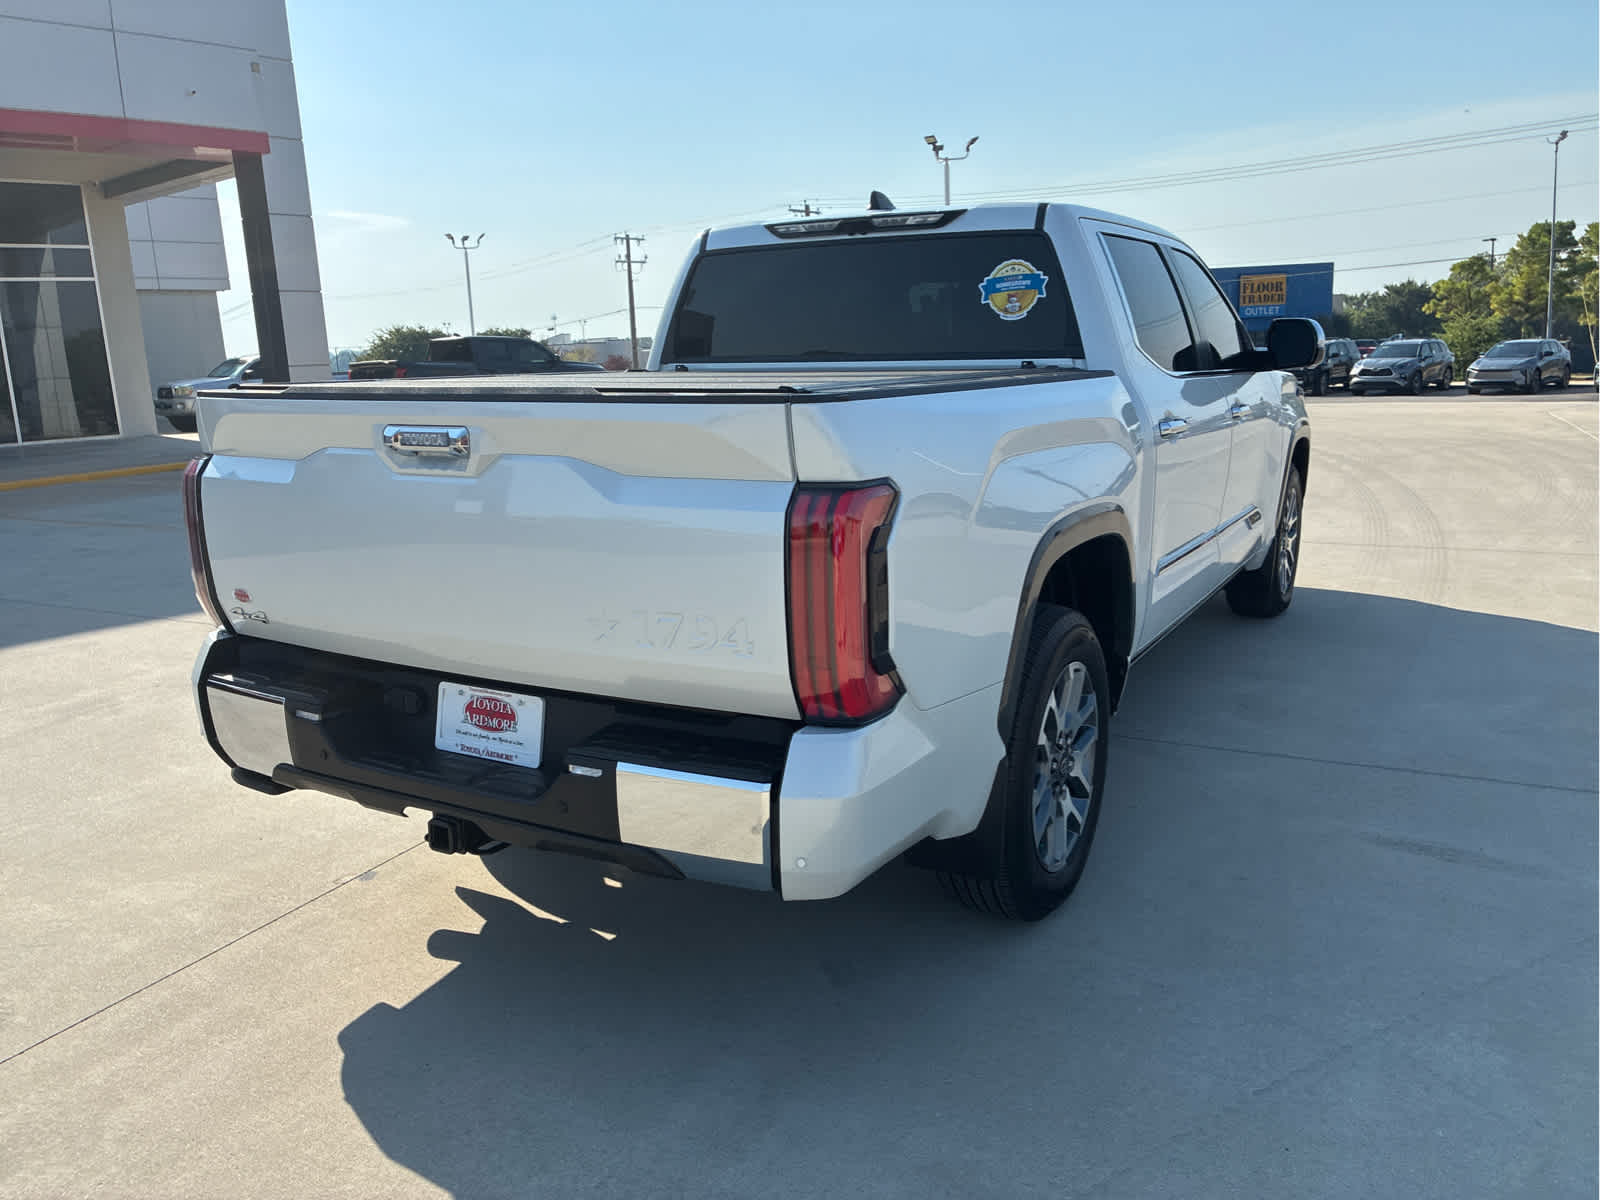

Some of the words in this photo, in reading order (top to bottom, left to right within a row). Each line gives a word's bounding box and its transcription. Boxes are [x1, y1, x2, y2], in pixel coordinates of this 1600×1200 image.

[1242, 281, 1284, 294] FLOOR
[1241, 293, 1284, 304] TRADER
[1244, 306, 1281, 315] OUTLET
[402, 432, 445, 446] TOYOTA
[631, 610, 754, 658] 1794
[471, 695, 513, 714] TOYOTA
[462, 711, 519, 732] ARDMORE
